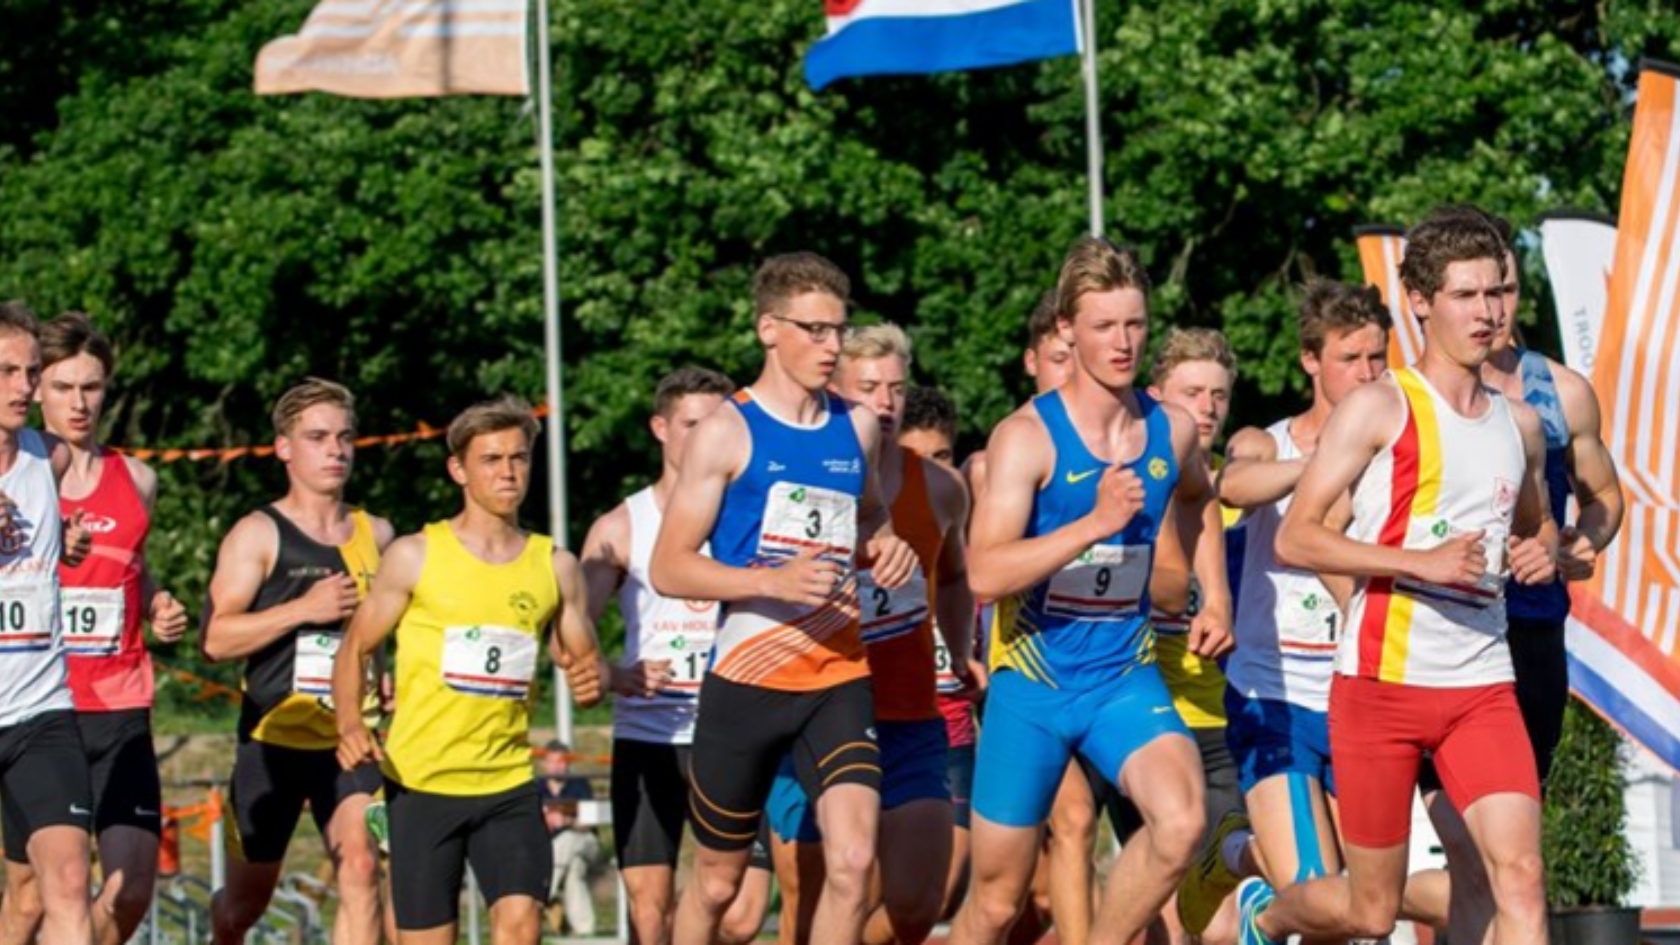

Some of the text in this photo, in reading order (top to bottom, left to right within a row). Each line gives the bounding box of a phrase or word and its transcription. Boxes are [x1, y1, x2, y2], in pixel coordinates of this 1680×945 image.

[805, 509, 822, 538] 3
[1094, 566, 1111, 597] 9
[0, 600, 24, 633] 10
[873, 588, 890, 616] 2
[66, 605, 96, 633] 19
[485, 645, 502, 675] 8
